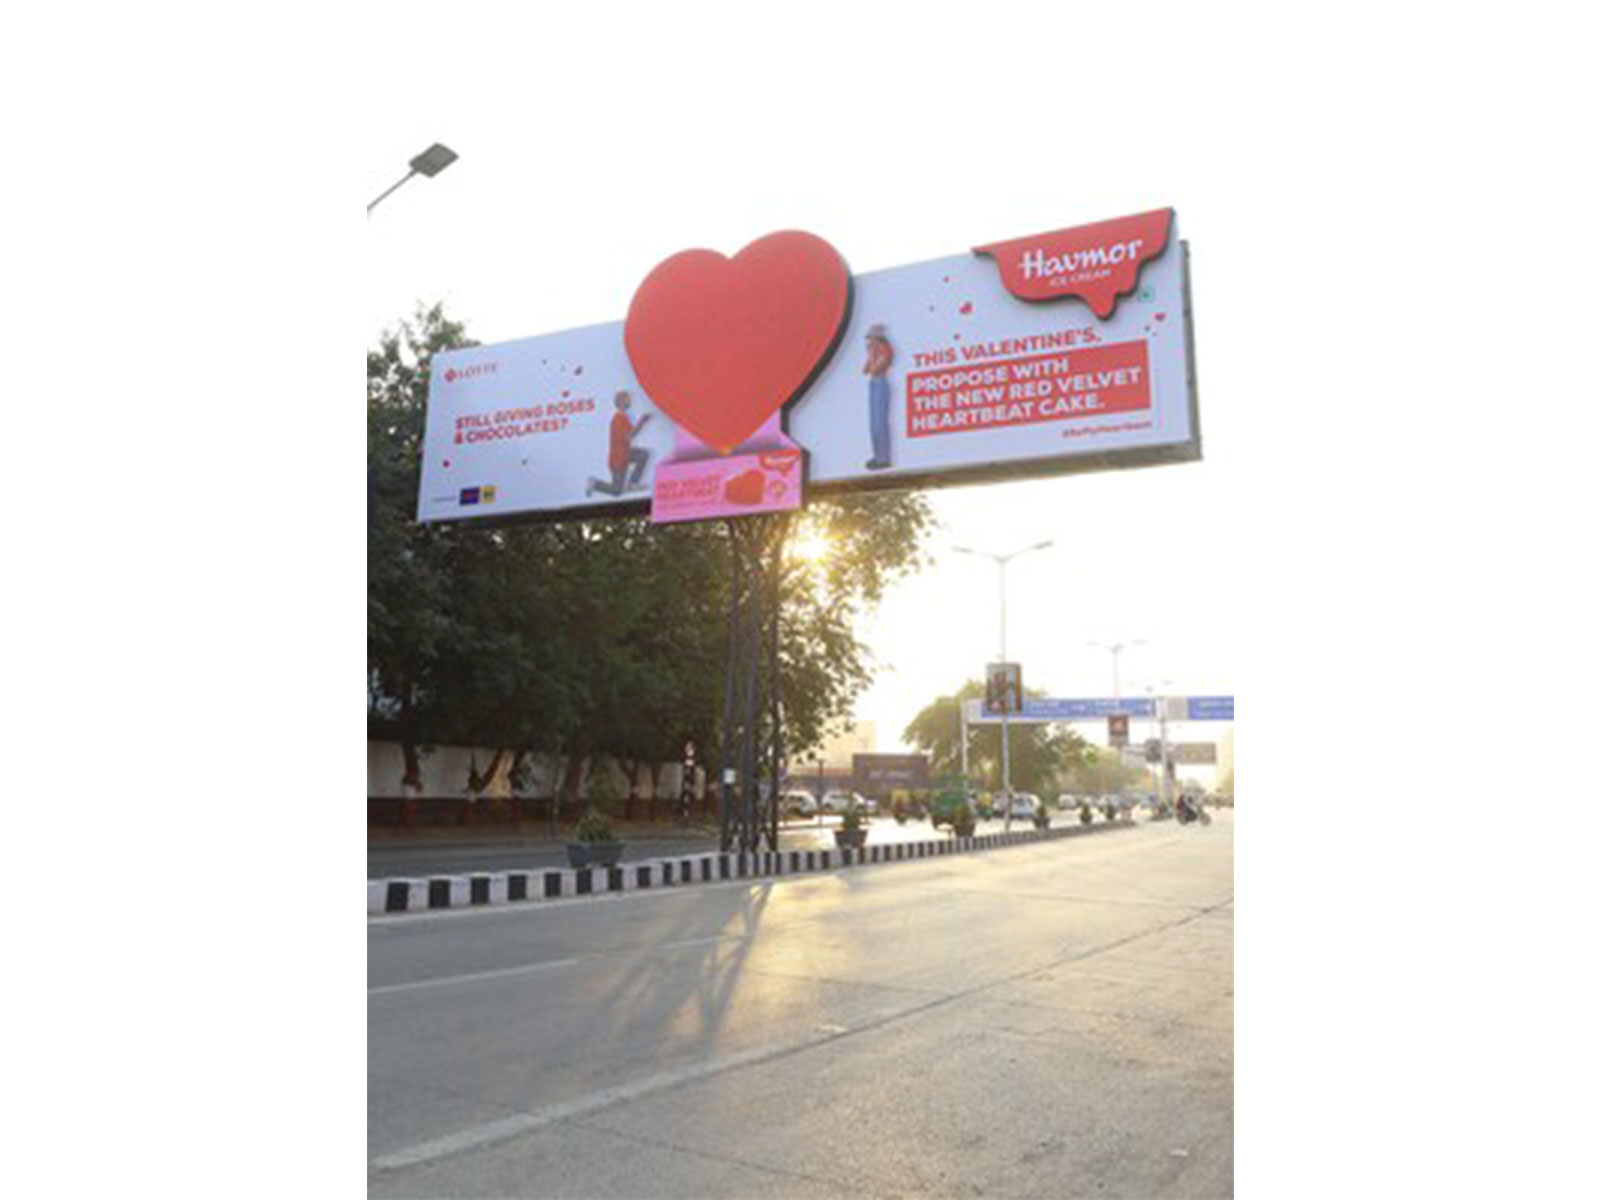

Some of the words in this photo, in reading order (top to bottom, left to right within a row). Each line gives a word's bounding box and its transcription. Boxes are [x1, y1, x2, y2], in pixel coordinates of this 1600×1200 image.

[1019, 239, 1143, 279] Havmor
[913, 347, 956, 368] THIS
[912, 367, 1008, 392] PROPOSE
[1013, 358, 1068, 380] WITH
[912, 392, 950, 412] THE
[955, 385, 1004, 406] NEW
[1008, 380, 1052, 400] RED
[1058, 366, 1142, 393] VELVET
[456, 415, 491, 429] STILL
[494, 406, 543, 423] GIVING
[546, 400, 595, 415] ROSES
[911, 401, 1034, 431] HEARTBEAT
[1038, 393, 1104, 417] CAKE.
[466, 418, 568, 443] CHOCOLATES?
